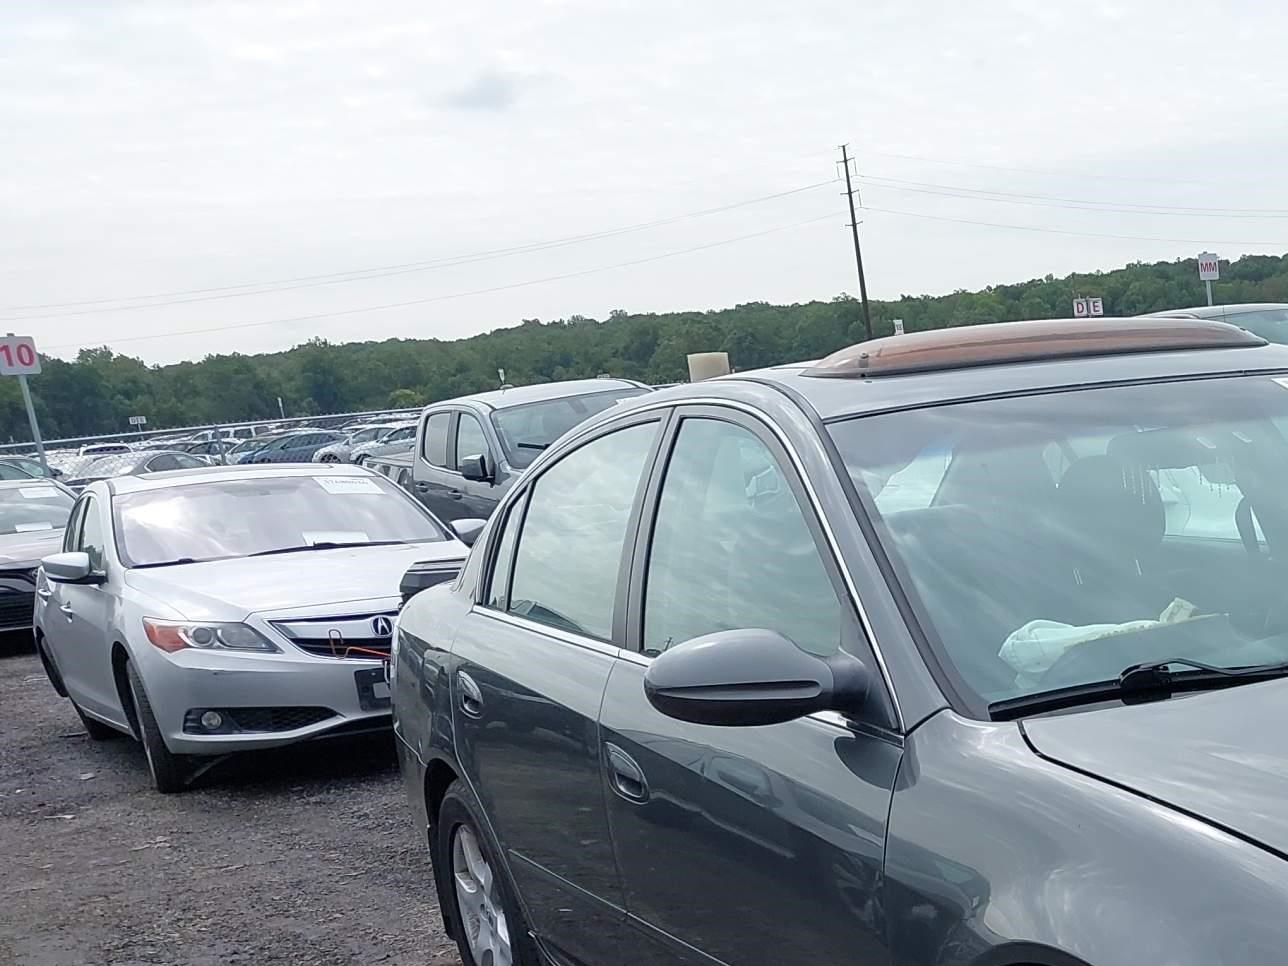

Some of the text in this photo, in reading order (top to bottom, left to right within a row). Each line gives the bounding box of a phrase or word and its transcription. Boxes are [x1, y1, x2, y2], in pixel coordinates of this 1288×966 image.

[1200, 262, 1217, 272] MM
[1076, 302, 1085, 314] D
[1092, 301, 1101, 313] E
[0, 344, 34, 367] 10
